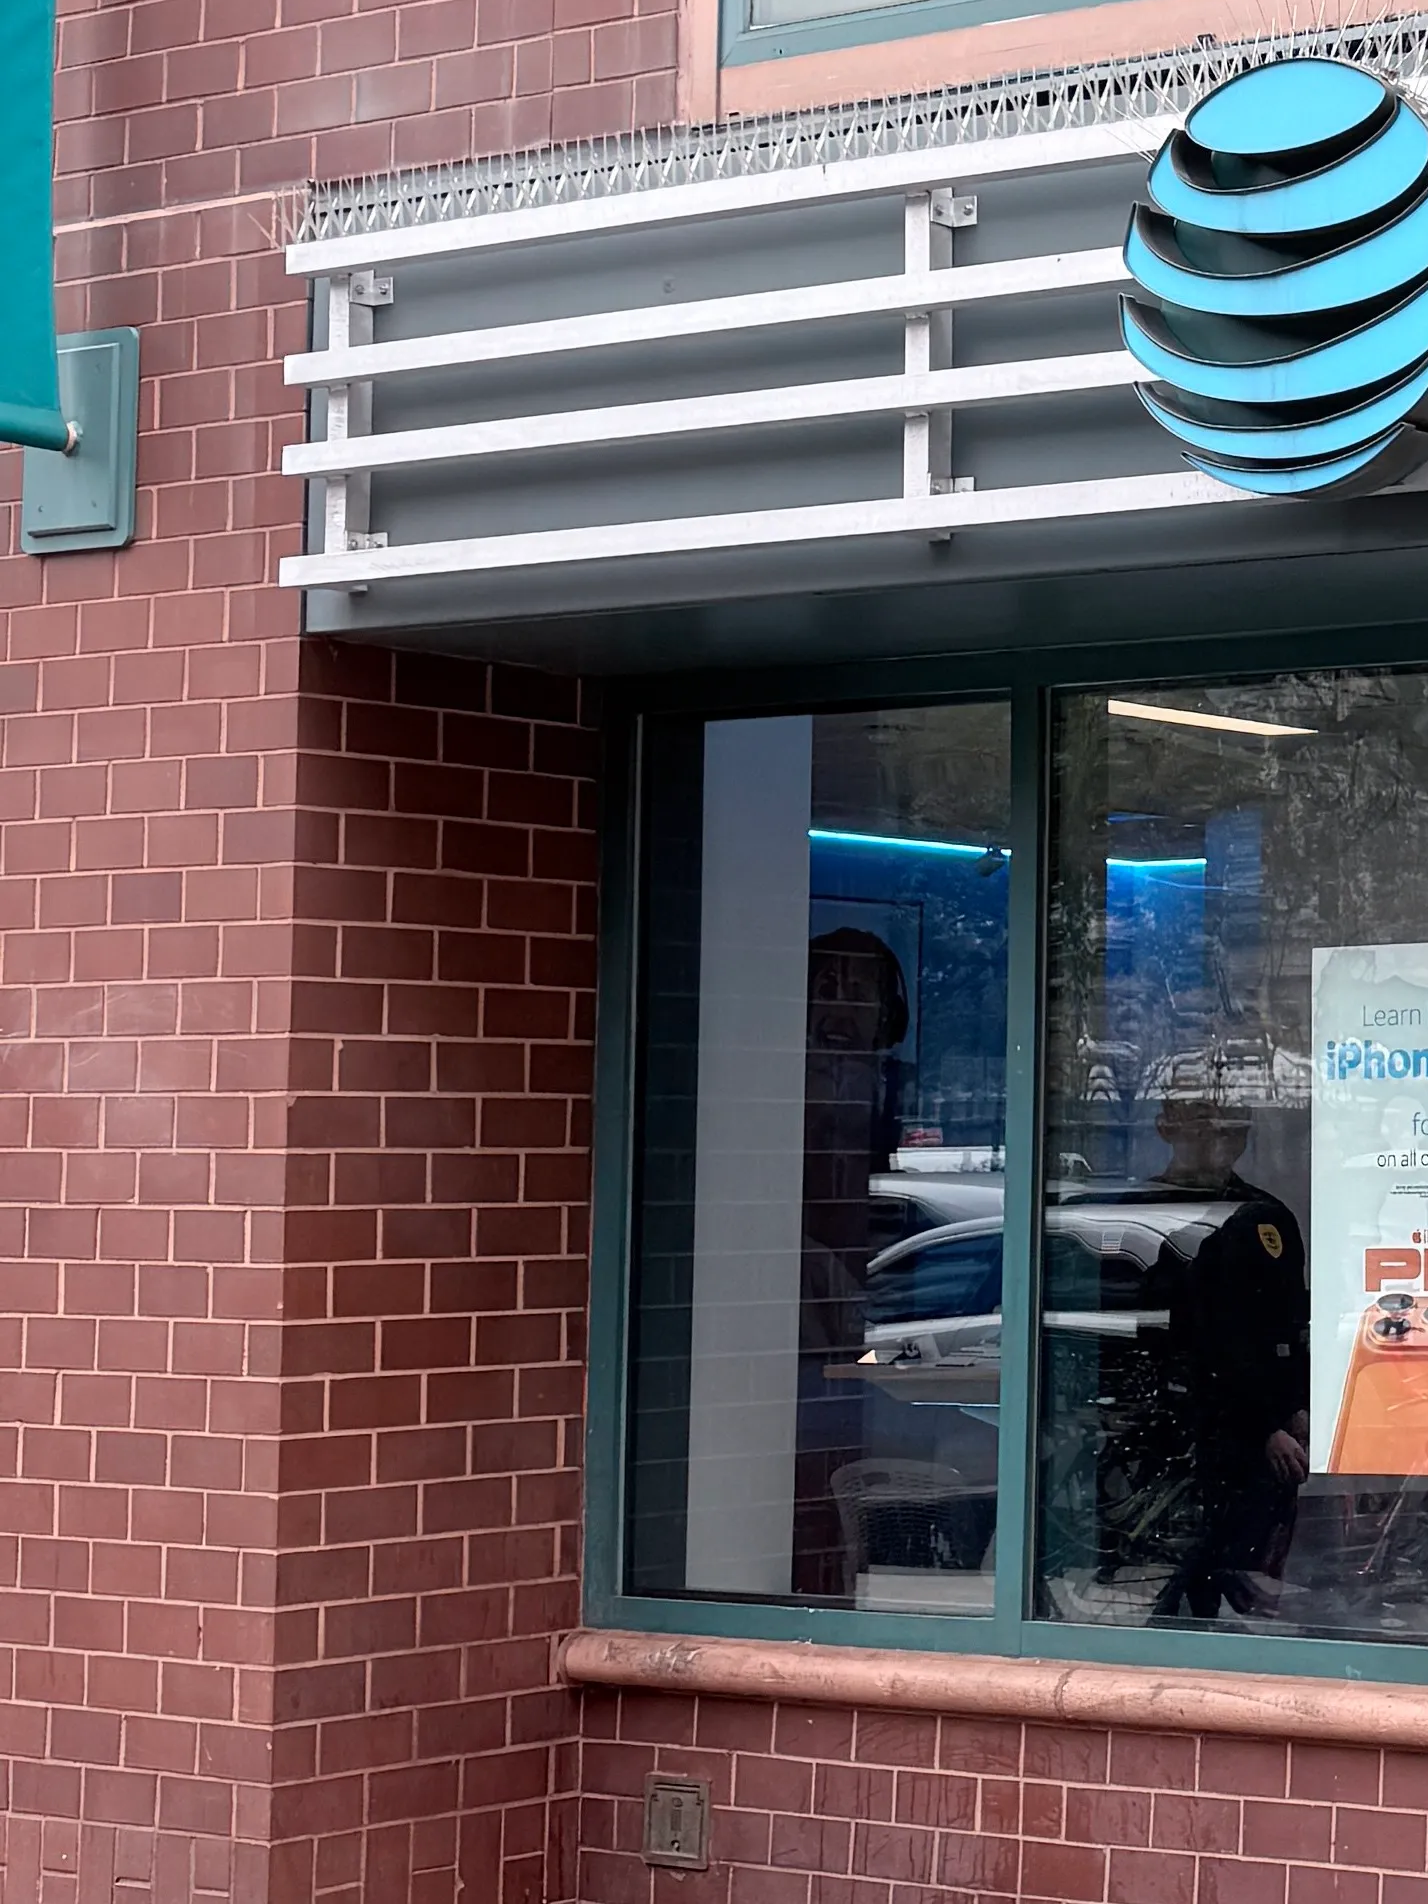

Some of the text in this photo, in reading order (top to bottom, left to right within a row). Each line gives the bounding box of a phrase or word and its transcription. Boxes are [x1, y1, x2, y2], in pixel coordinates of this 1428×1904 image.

[1362, 1004, 1421, 1027] Learn
[1377, 1153, 1397, 1168] on
[1400, 1149, 1417, 1167] all
